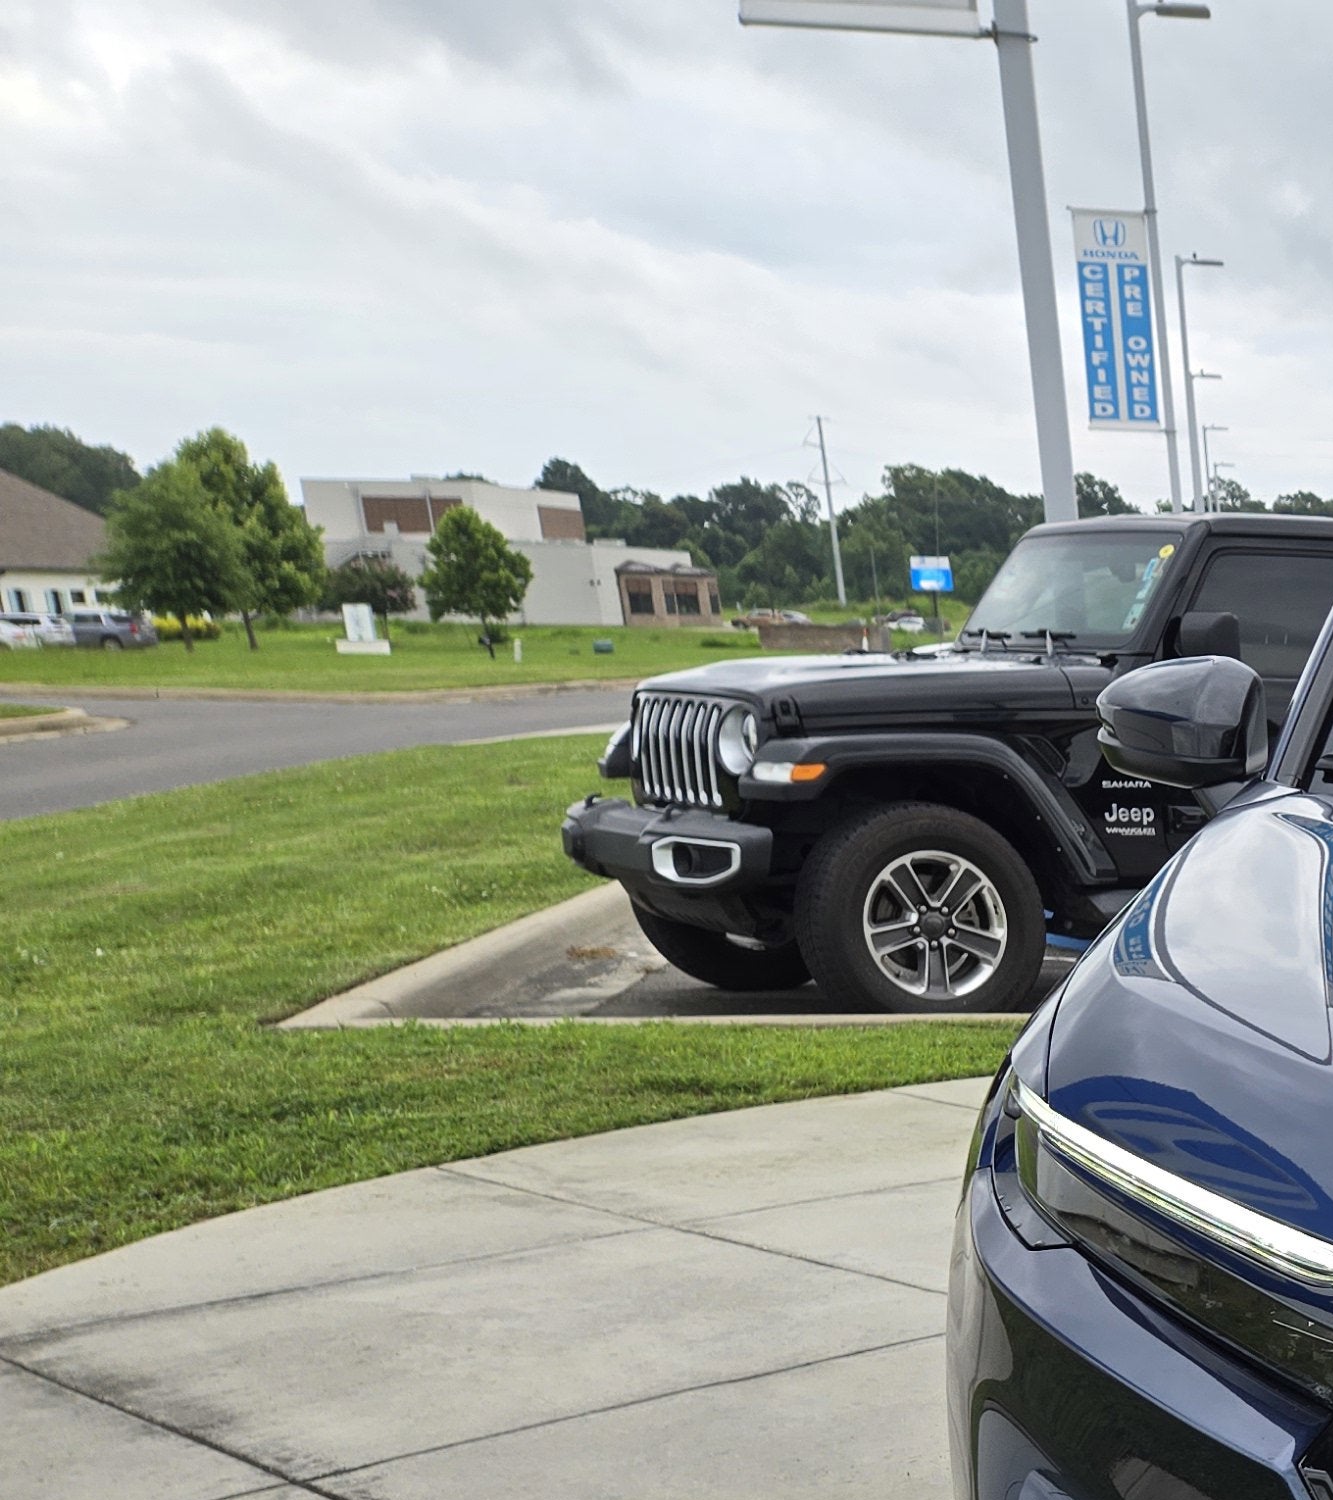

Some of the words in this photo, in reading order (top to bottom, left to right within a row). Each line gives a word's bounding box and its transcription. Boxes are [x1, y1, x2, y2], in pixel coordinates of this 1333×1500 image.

[1082, 249, 1140, 261] HONDA
[1123, 267, 1143, 317] PRE
[1082, 266, 1116, 419] CERTIFIED
[1126, 335, 1152, 418] OWNED
[1101, 780, 1152, 789] SAHARA
[1104, 803, 1155, 825] Jeep
